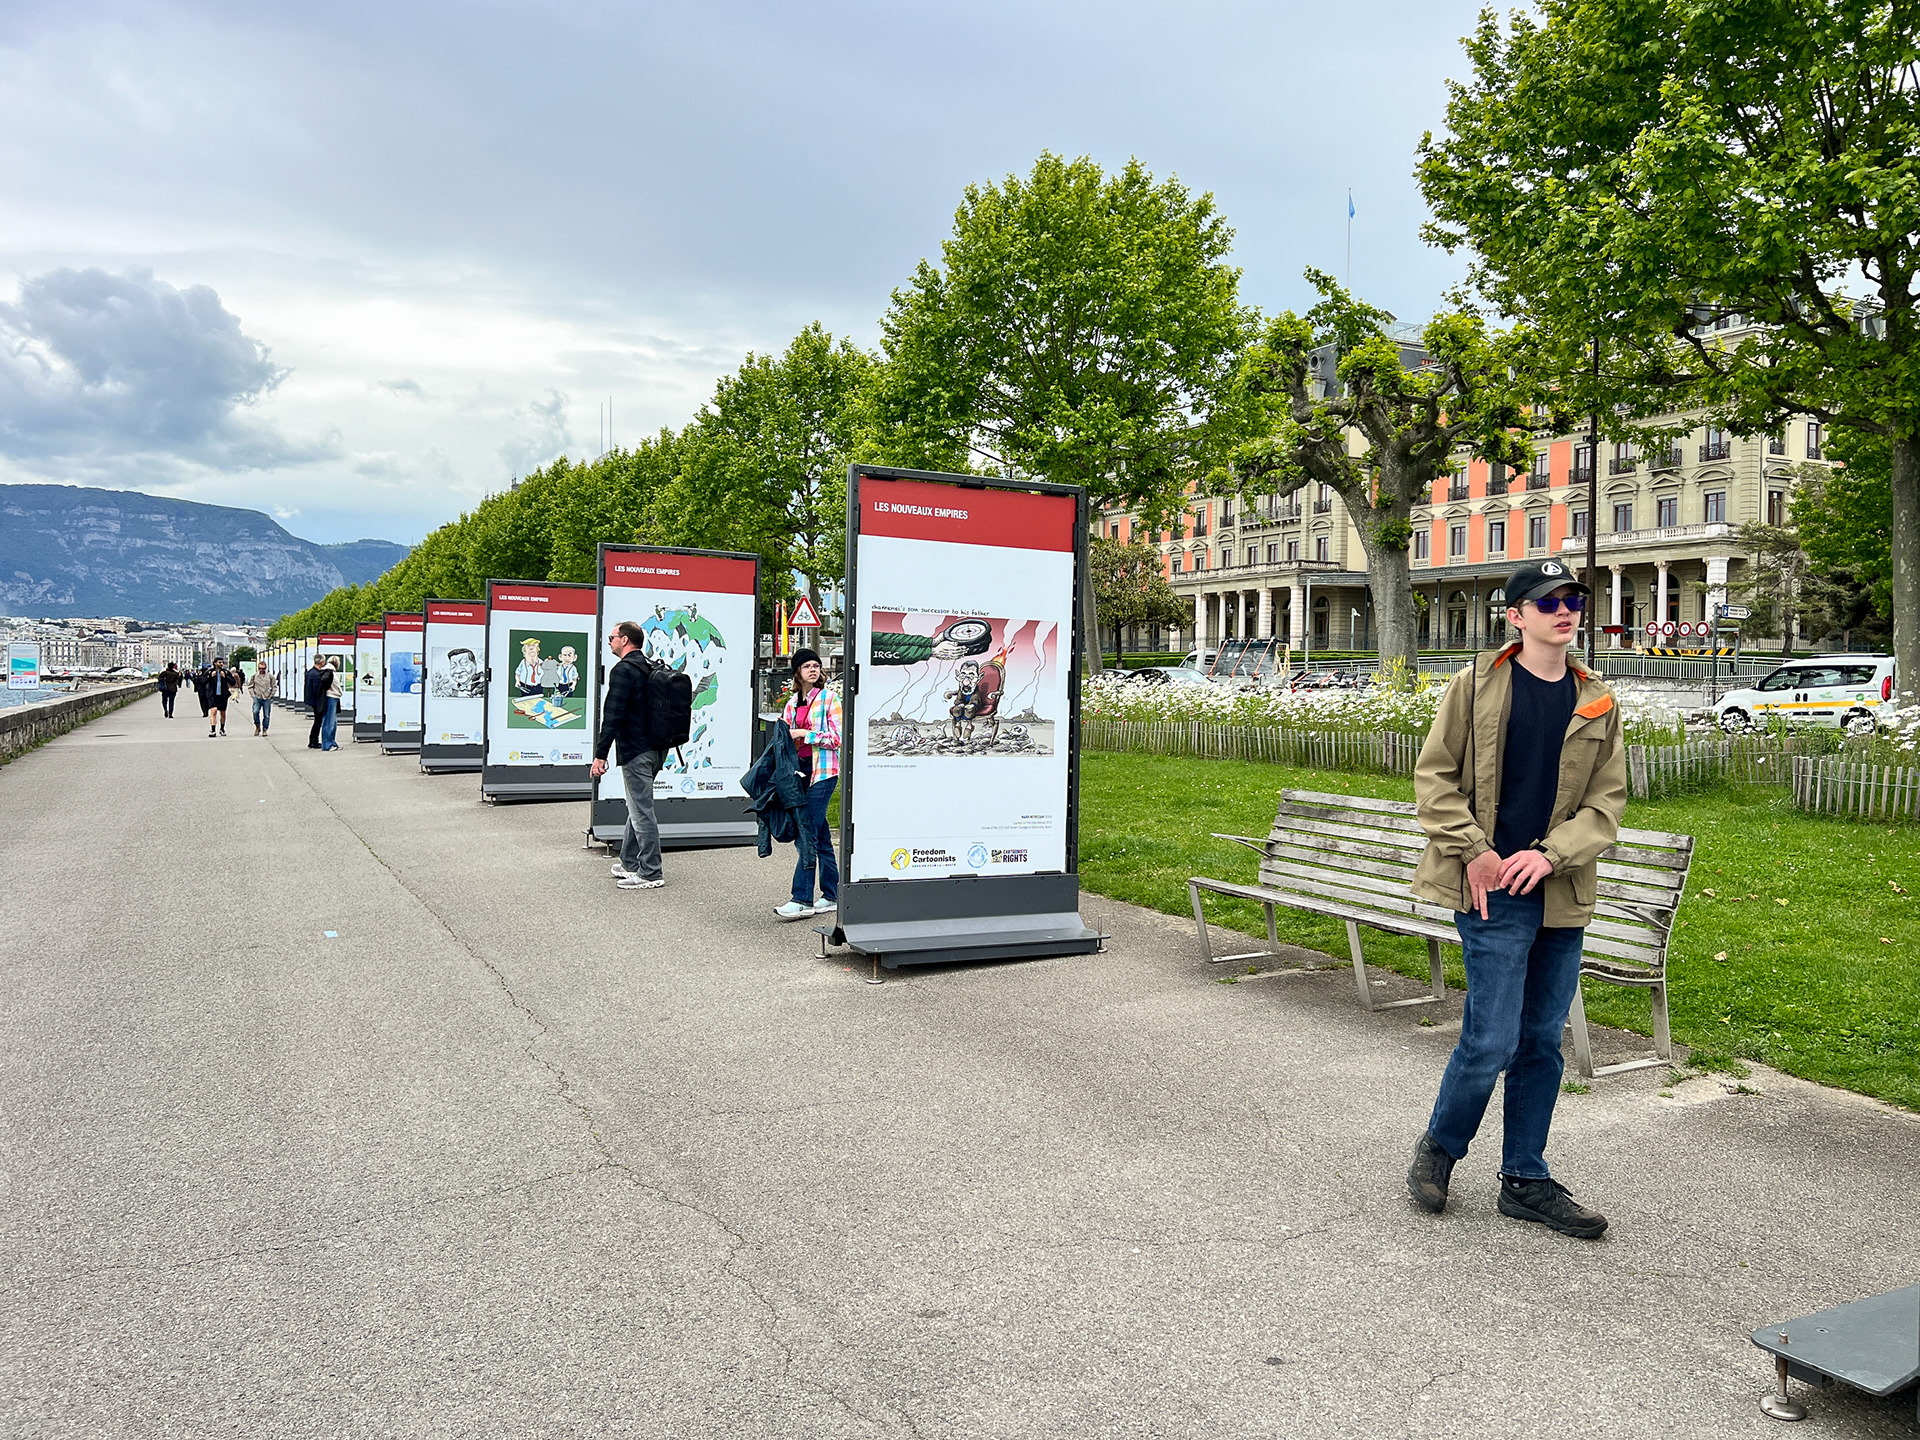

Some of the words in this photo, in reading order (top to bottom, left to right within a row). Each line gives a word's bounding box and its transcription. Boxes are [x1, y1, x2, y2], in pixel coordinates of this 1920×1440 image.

[874, 501, 890, 512] LES
[891, 503, 933, 517] NOUVEAUX
[934, 508, 969, 520] EMPIRES
[626, 566, 656, 574] NOUVEAUX
[656, 568, 680, 576] EMPIRES
[872, 650, 900, 659] IRGC
[912, 855, 956, 863] Cartoonists
[1003, 854, 1028, 863] RIGHTS
